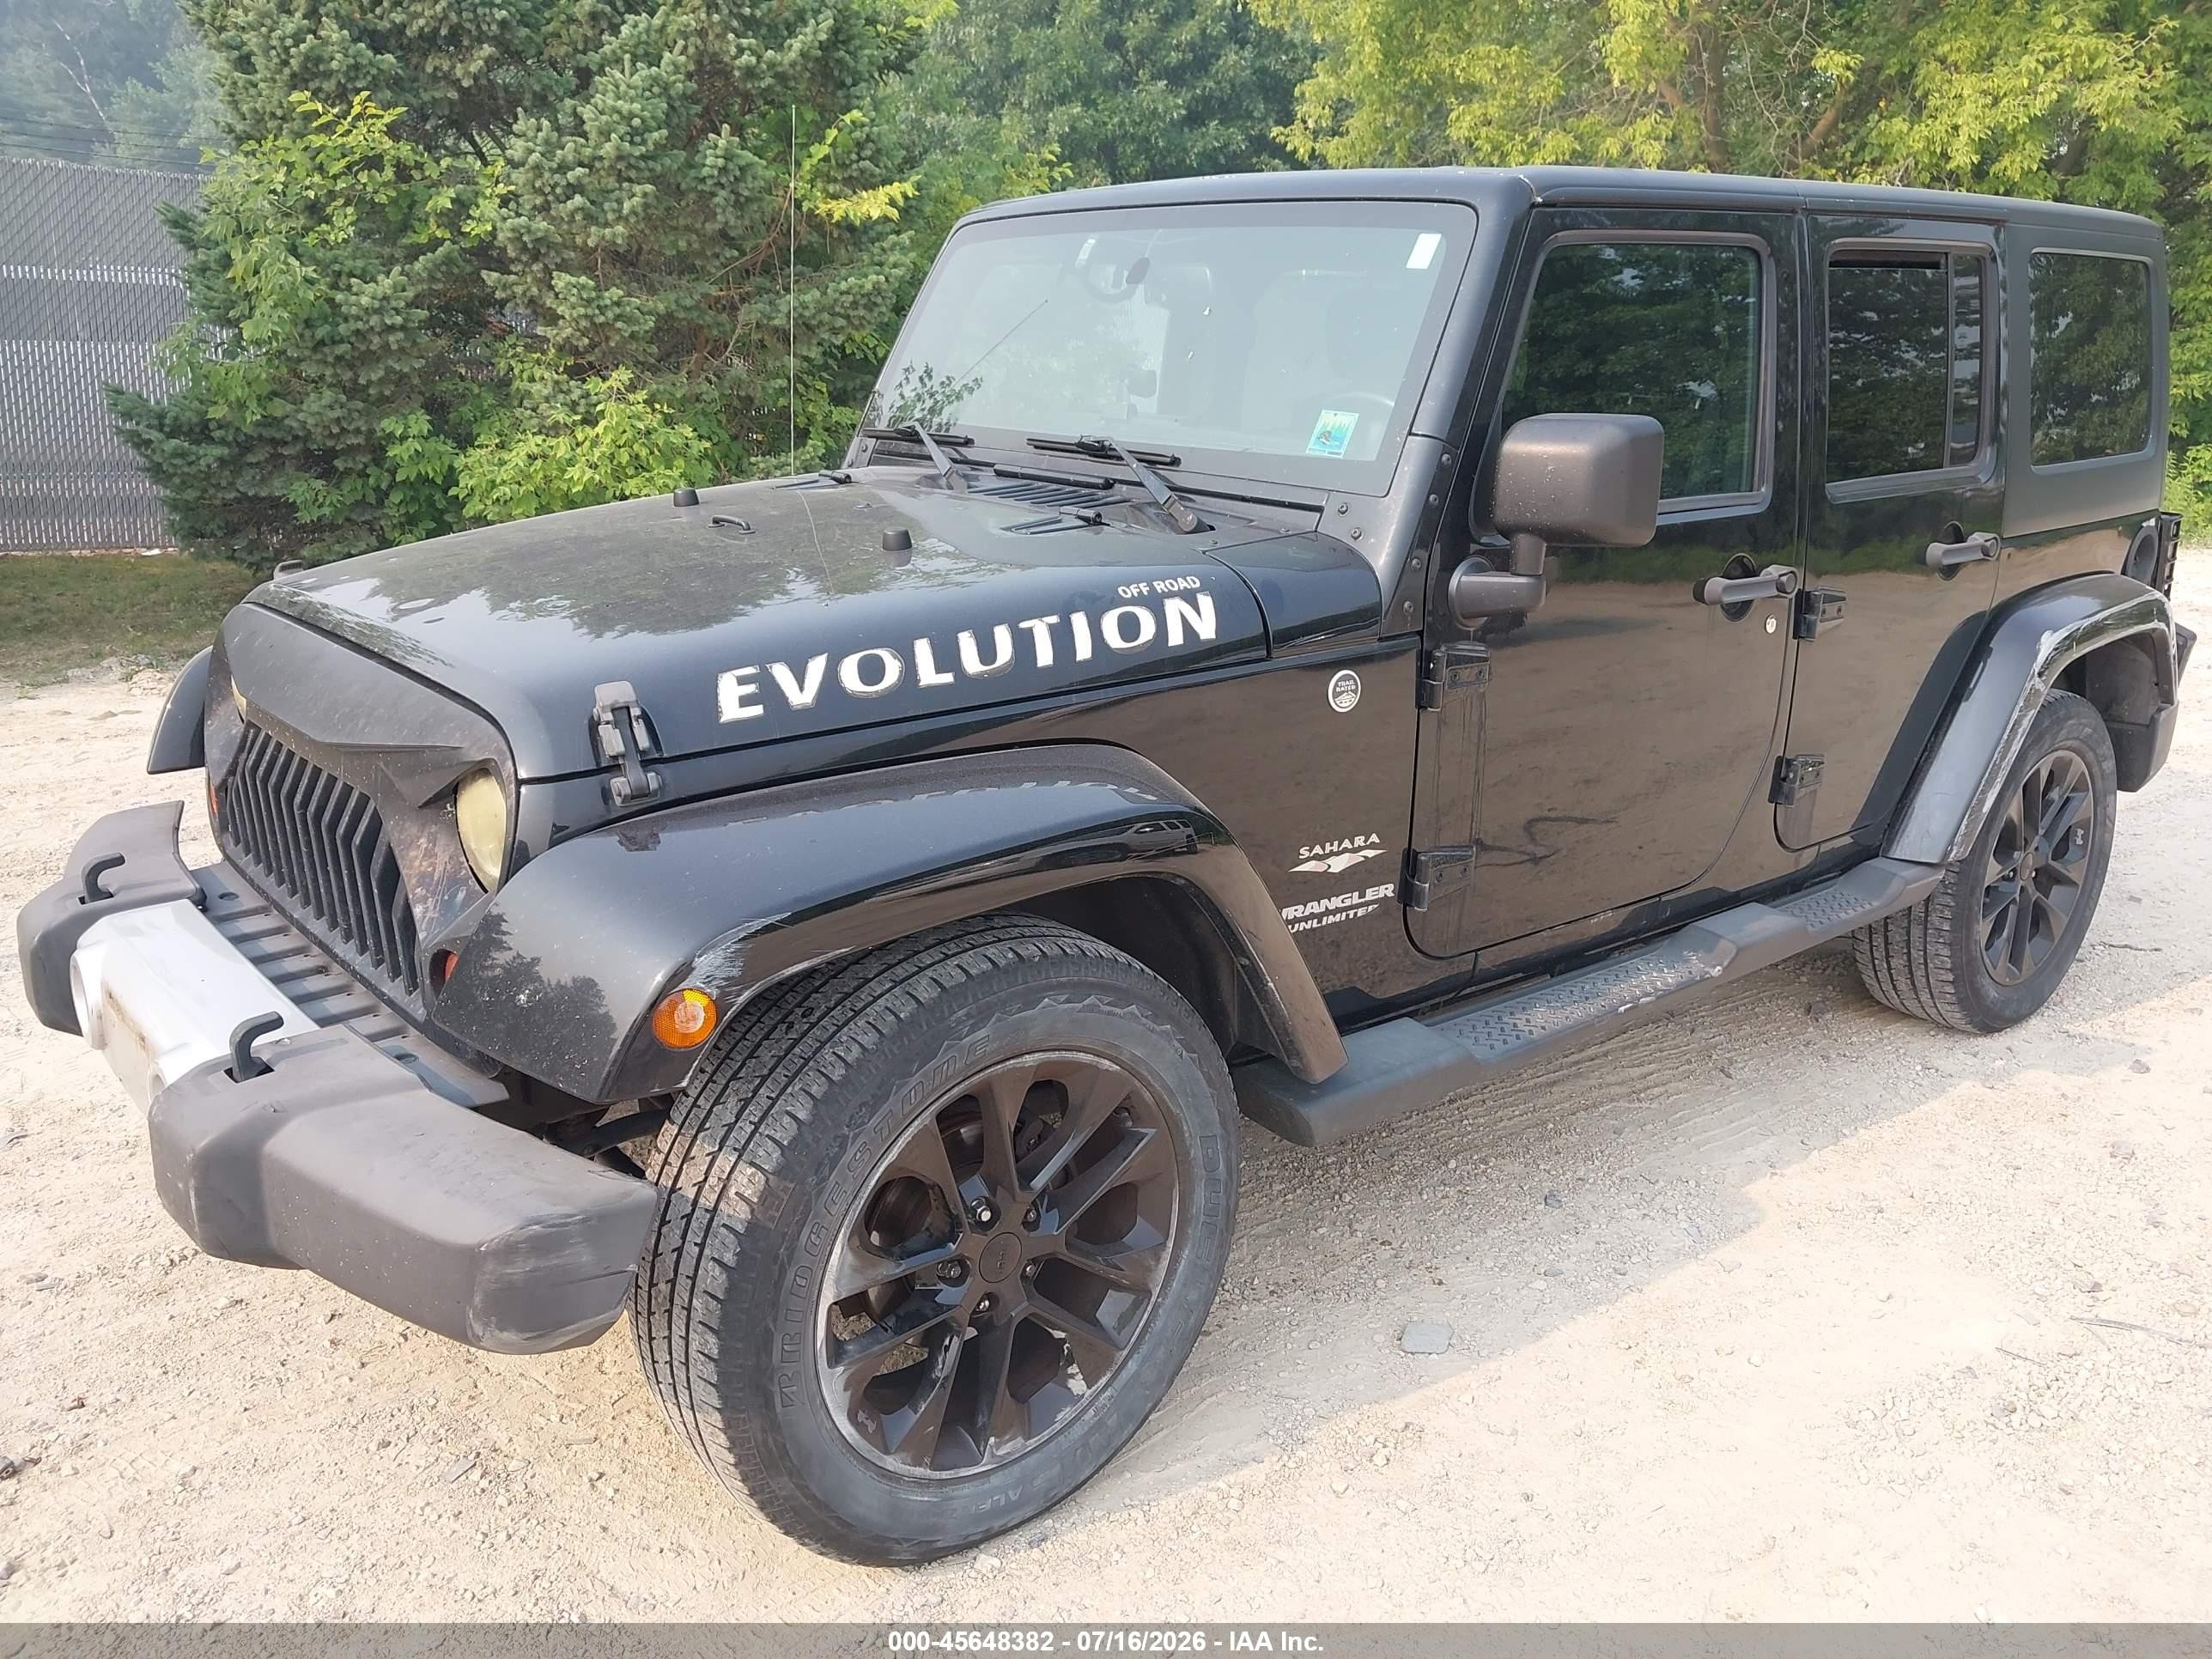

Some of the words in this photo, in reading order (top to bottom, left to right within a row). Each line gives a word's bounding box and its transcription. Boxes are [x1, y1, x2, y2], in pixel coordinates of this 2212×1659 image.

[1117, 583, 1150, 599] OFF
[1152, 576, 1200, 593] ROAD
[718, 591, 1217, 723] EVOLUTION
[1298, 833, 1380, 859] SAHARA
[1288, 903, 1380, 933] UNLIMITED
[779, 1035, 992, 1409] BRIDGESTONE
